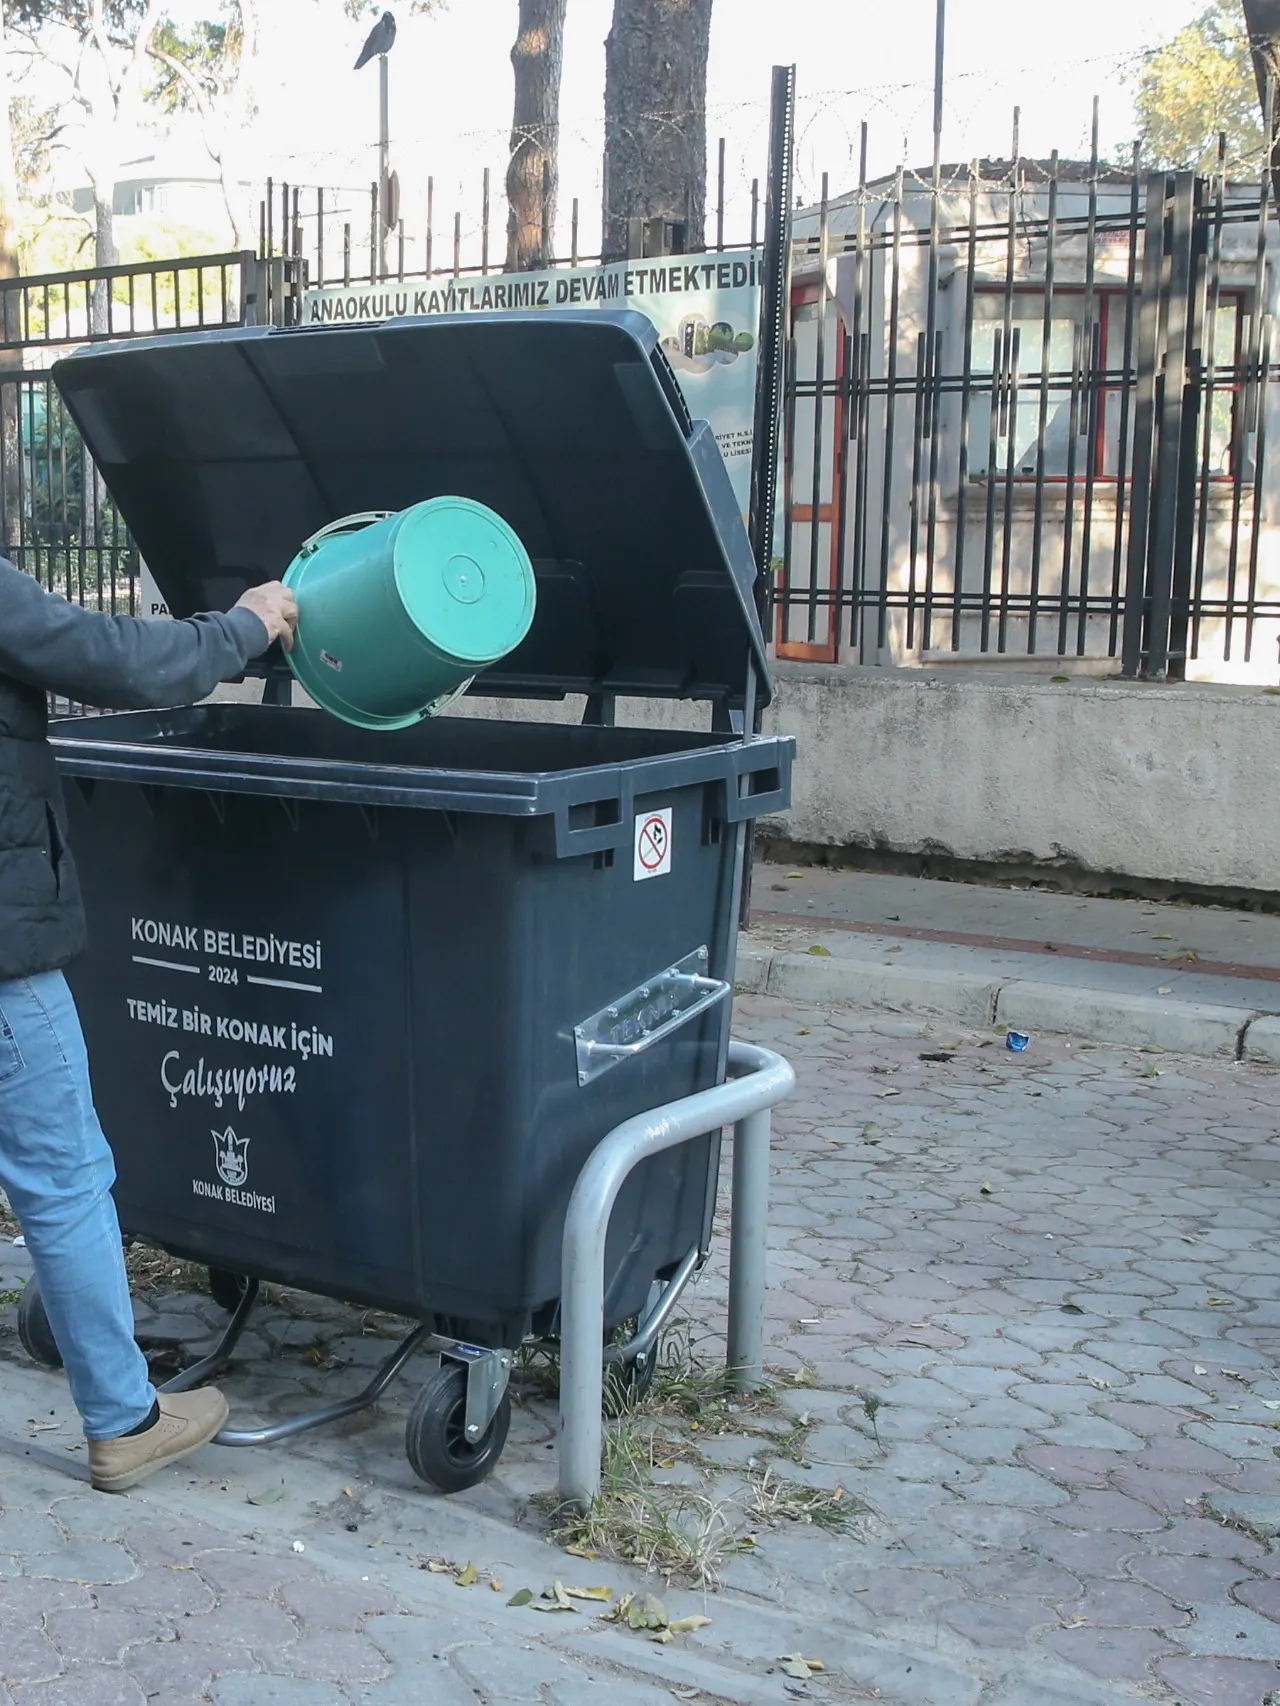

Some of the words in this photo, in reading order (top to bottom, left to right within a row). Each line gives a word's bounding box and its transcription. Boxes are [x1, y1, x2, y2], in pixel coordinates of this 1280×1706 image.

[310, 292, 408, 322] ANAOKULU
[556, 273, 619, 304] DEVAM
[151, 602, 169, 616] PA
[131, 917, 199, 951] KONAK
[203, 928, 322, 970] BELEDİYESİ
[208, 965, 239, 986] 2024
[127, 998, 179, 1029] TEMİZ
[182, 1005, 212, 1036] BİR
[216, 1015, 287, 1050] KONAK
[291, 1022, 334, 1061] İÇİN
[160, 1050, 297, 1112] Çalışıyoruz
[192, 1178, 224, 1201] KONAK
[225, 1186, 276, 1214] BELEDİYESİ
